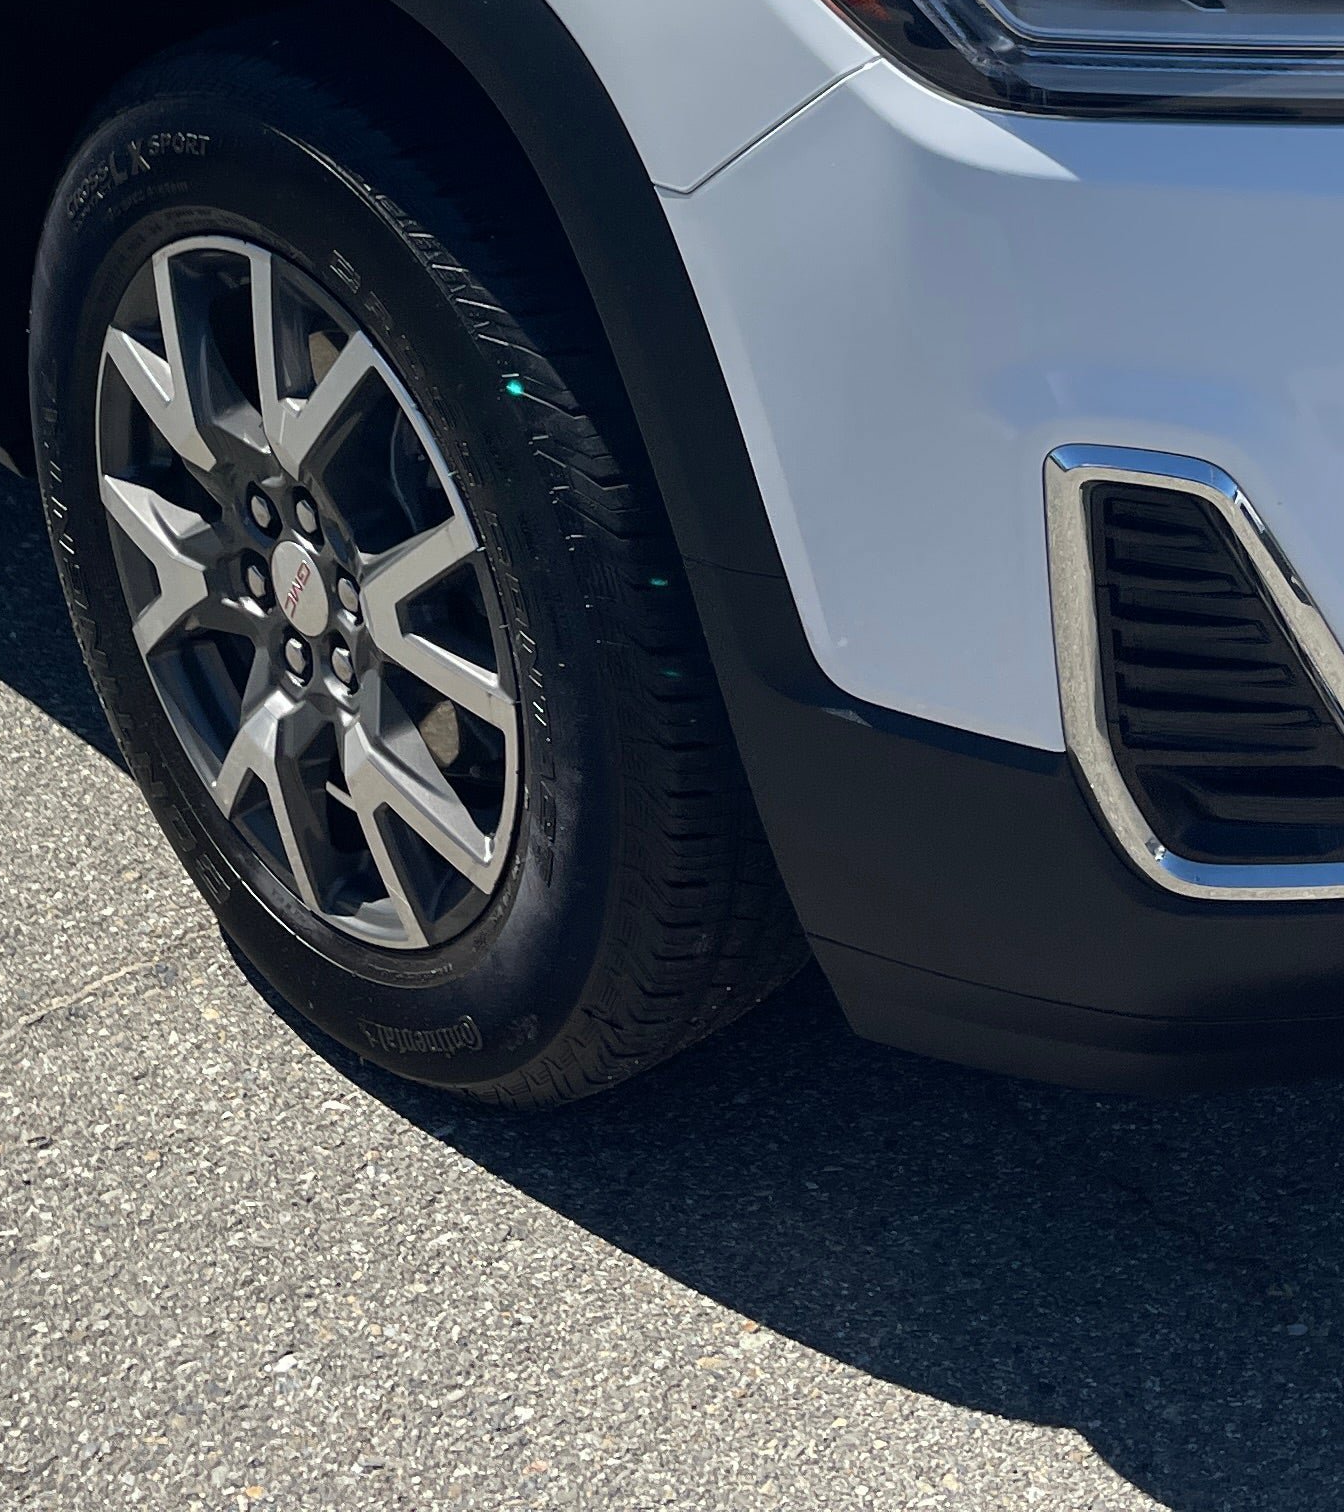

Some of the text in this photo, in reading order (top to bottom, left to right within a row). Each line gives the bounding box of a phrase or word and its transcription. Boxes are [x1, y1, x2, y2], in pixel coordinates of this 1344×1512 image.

[148, 131, 212, 157] SPORT
[284, 559, 311, 619] GMC
[376, 1014, 484, 1060] Continental
